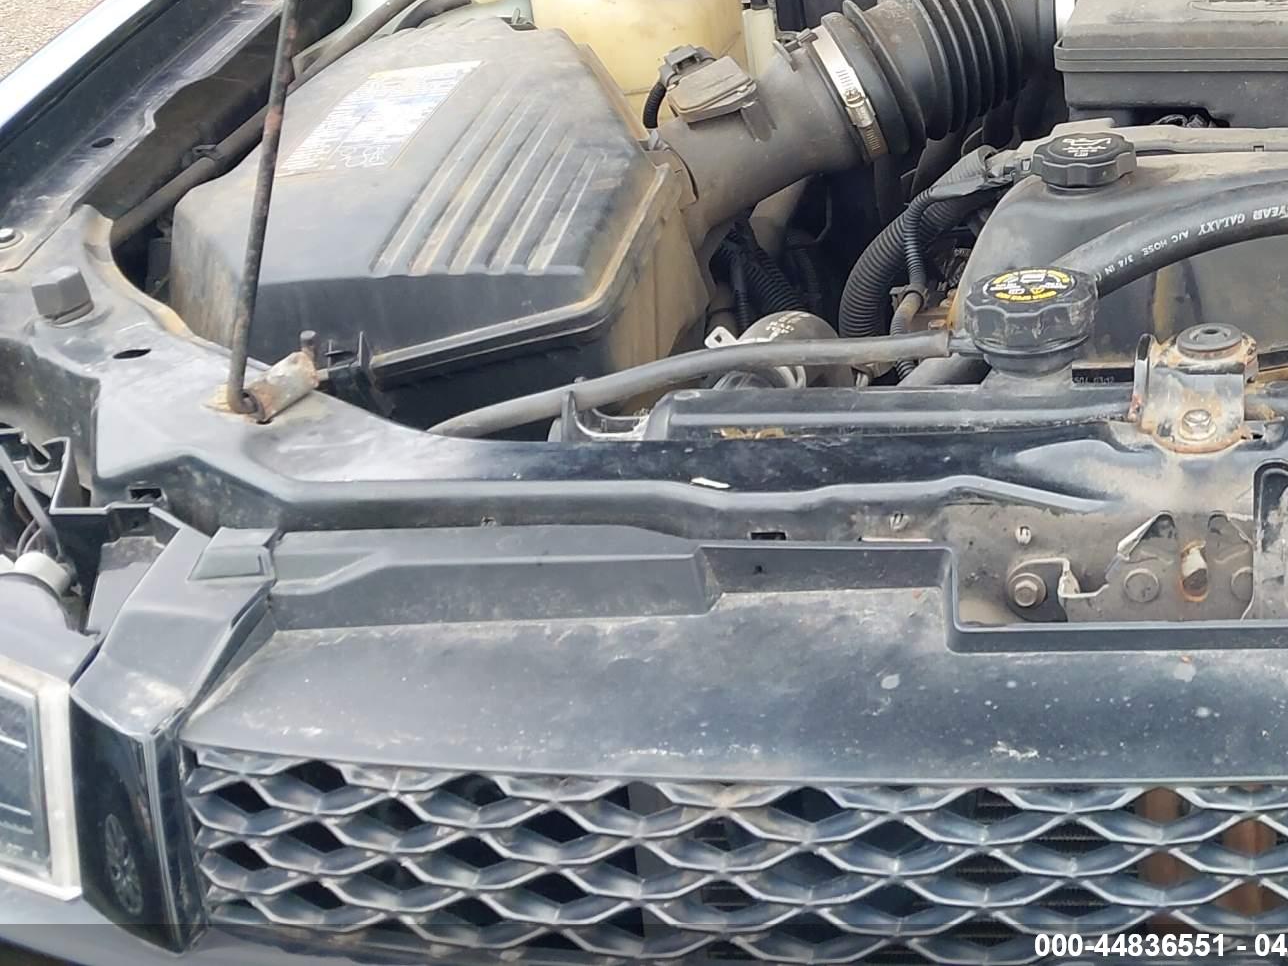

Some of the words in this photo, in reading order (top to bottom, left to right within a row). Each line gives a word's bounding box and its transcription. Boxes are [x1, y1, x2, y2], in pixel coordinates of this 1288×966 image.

[1197, 213, 1246, 235] GALAXY
[1171, 230, 1189, 242] A/C
[1142, 240, 1168, 255] HOSE
